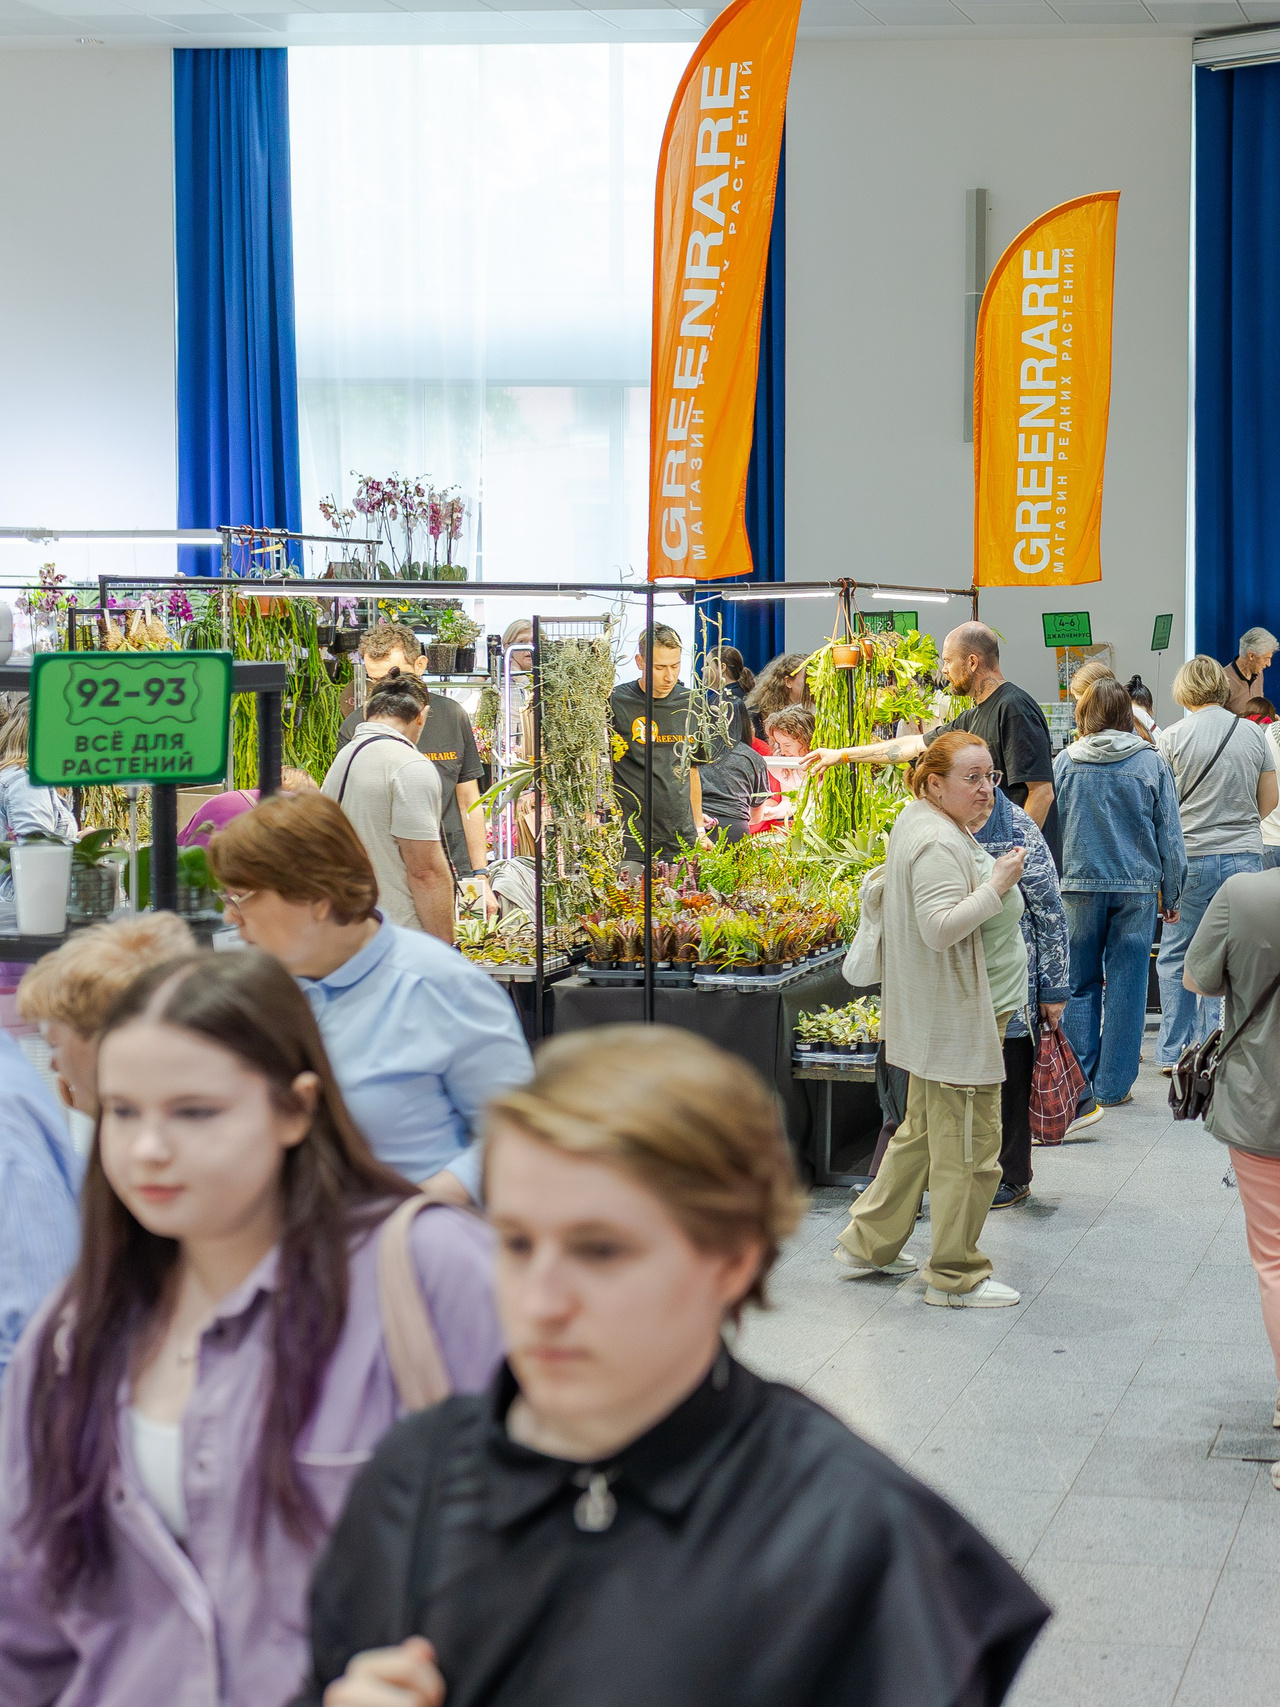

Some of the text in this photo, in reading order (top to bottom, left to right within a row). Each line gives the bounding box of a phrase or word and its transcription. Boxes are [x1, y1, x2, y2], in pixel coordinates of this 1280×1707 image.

[661, 62, 738, 561] GREENRARE
[690, 61, 753, 560] МАГАЗИН РАСТЕНИЙ
[1013, 249, 1060, 574] GREENRARE
[1053, 248, 1075, 573] МАГАЗИН РЕДКИХ РАСТЕНИЙ
[76, 677, 186, 708] 92-93
[1059, 618, 1075, 627] 4-6
[62, 752, 194, 776] РАСТЕНИЙ
[75, 731, 184, 754] ВСЁ ДЛЯ
